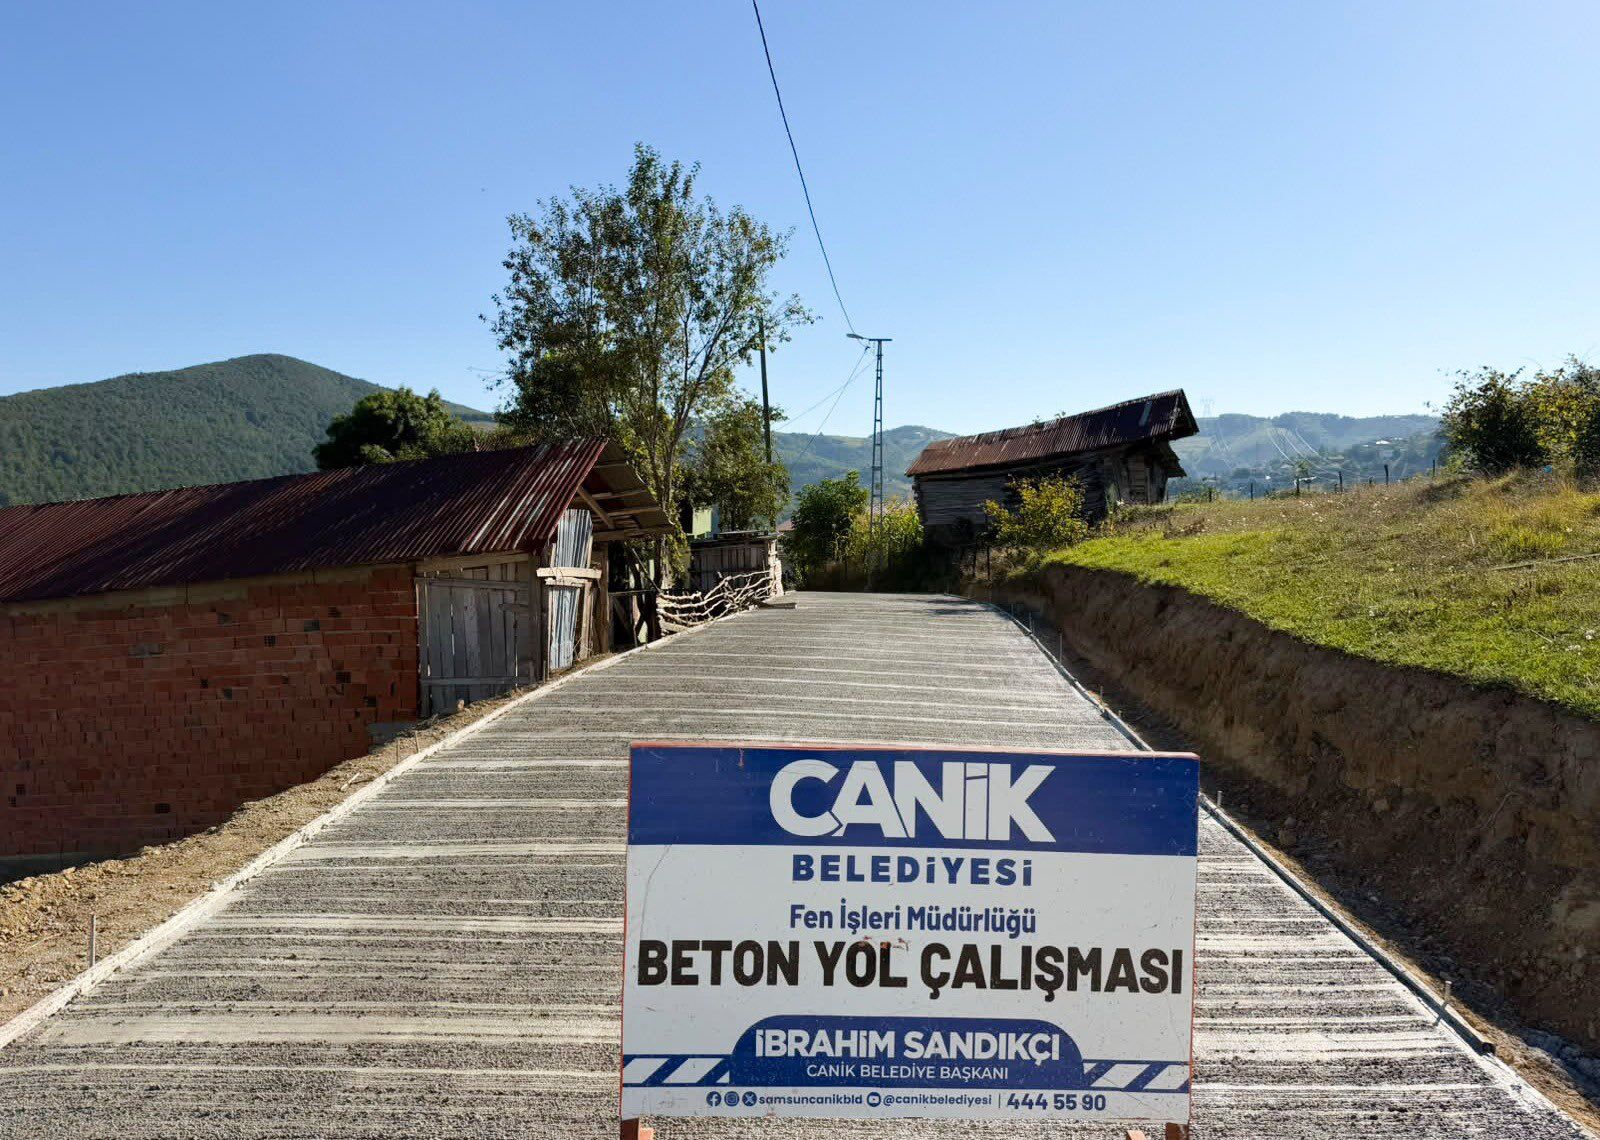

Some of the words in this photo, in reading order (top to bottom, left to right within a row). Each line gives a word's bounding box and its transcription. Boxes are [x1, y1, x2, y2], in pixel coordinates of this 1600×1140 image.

[769, 758, 1057, 844] CANİK
[791, 853, 1034, 887] BELEDİYESİ
[790, 903, 833, 930] Fen
[840, 897, 902, 936] İşleri
[907, 904, 1037, 939] Müdürlüğü
[638, 939, 801, 987] BETON
[815, 941, 908, 988] YOL
[920, 944, 1183, 1003] ÇALIŞMASI
[755, 1028, 895, 1059] İBRAHİM
[903, 1030, 1061, 1064] SANDIKÇI
[806, 1061, 857, 1078] CANİK
[860, 1062, 937, 1079] BELEDİYE
[941, 1065, 1009, 1083] BAŞKANI
[758, 1094, 862, 1106] samsuncanikbld
[883, 1093, 992, 1108] @canikbelediyesi
[1006, 1092, 1049, 1110] 444
[1053, 1093, 1078, 1110] 55
[1081, 1093, 1107, 1111] 90
